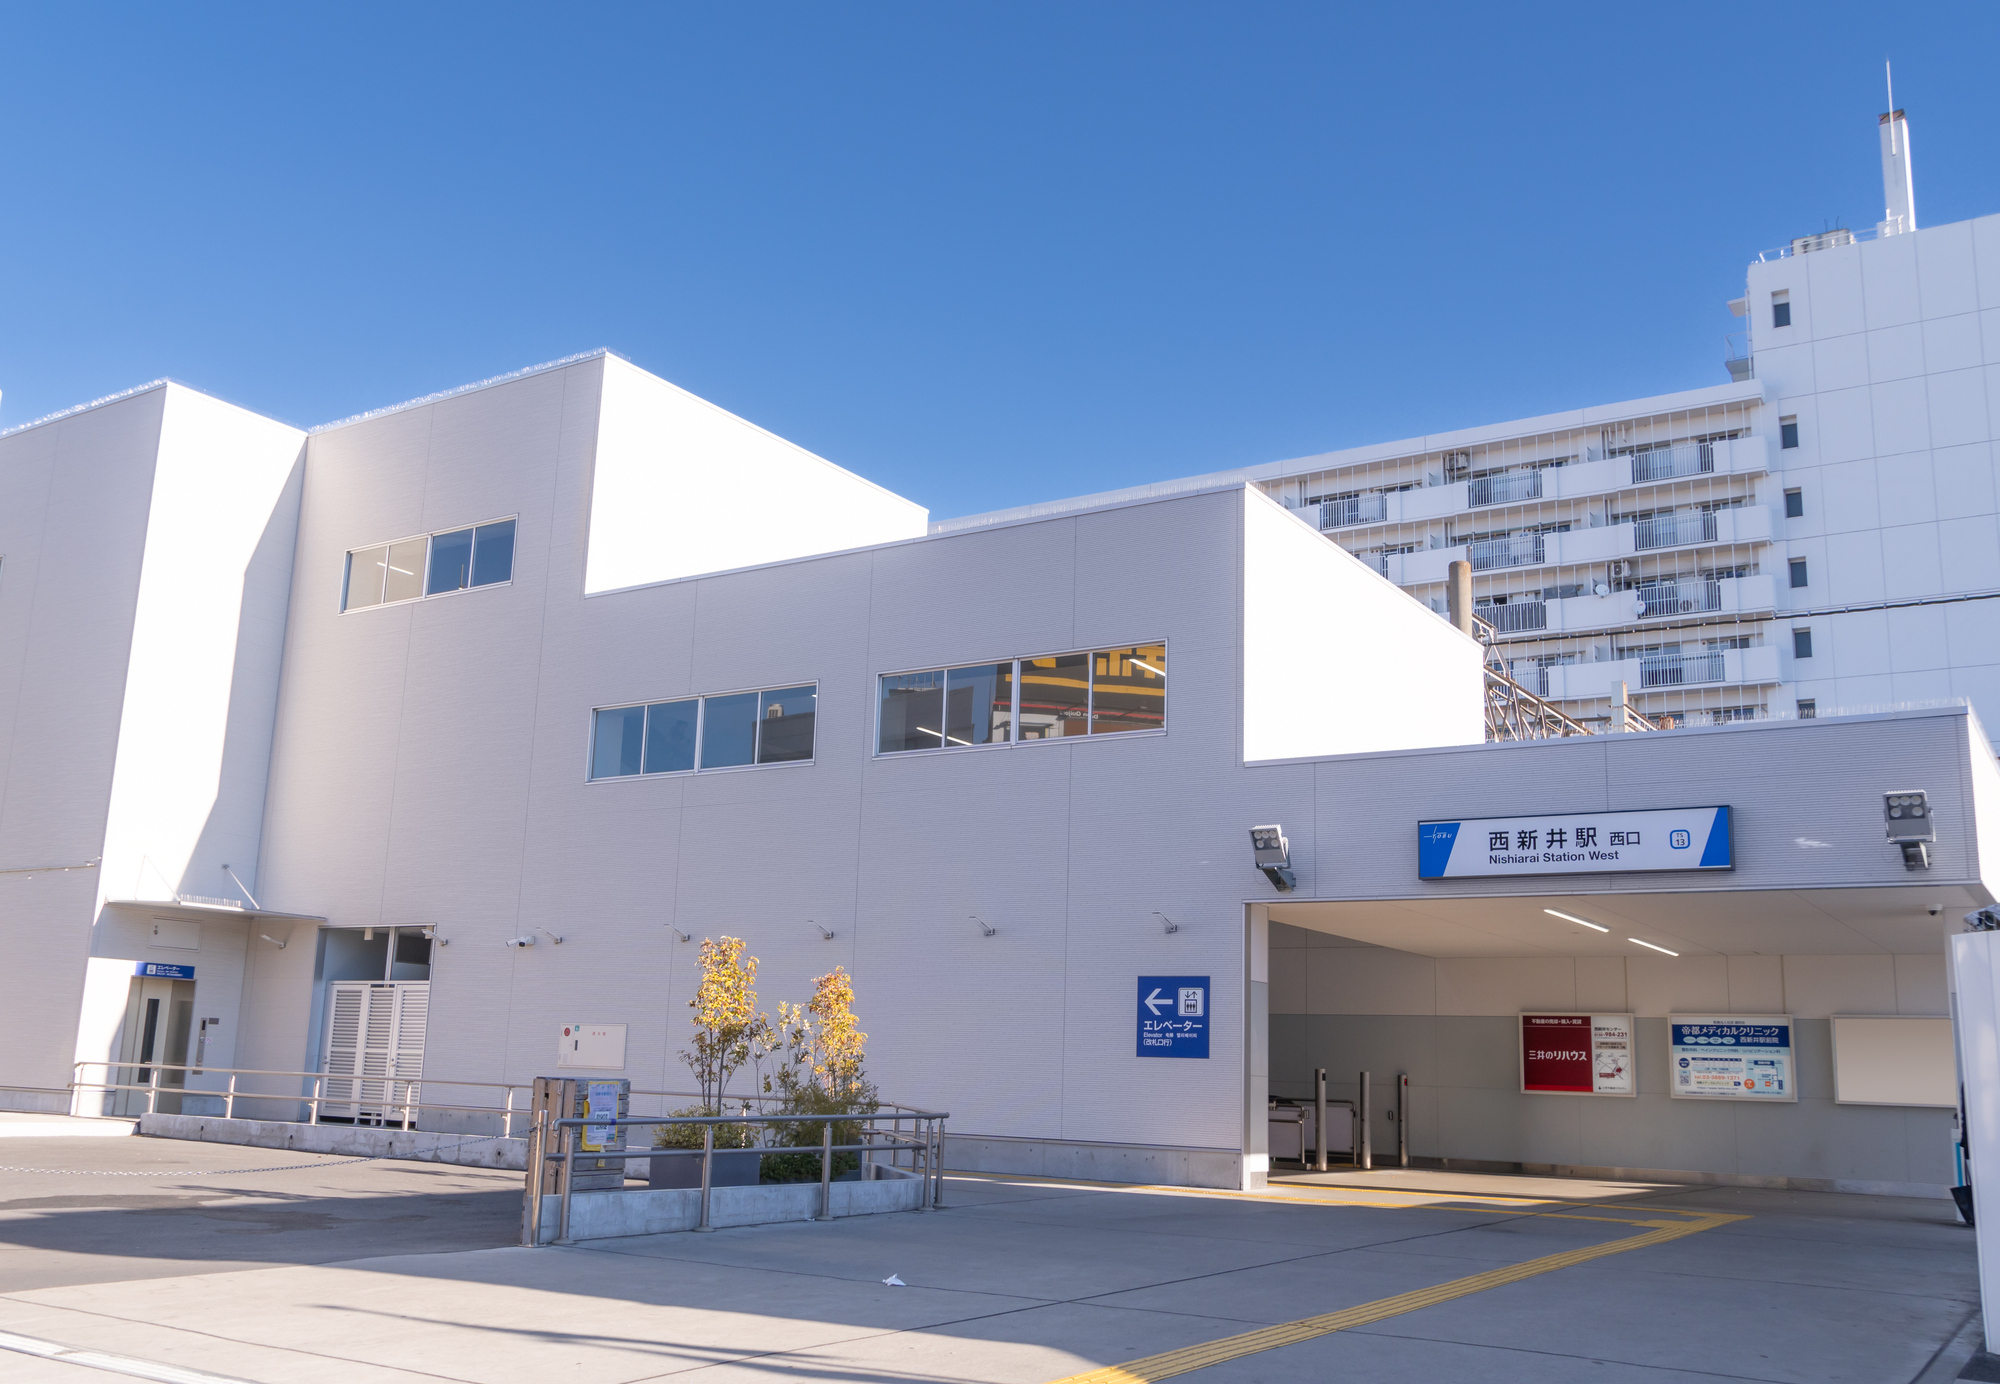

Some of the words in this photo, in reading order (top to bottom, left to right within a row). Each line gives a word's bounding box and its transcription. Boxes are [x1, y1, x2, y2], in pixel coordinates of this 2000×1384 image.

[1488, 827, 1598, 851] 西新井駅
[1609, 831, 1641, 846] 西口
[1675, 838, 1685, 846] 13
[1488, 852, 1540, 865] Nishiarai
[1543, 851, 1585, 863] Station
[1588, 850, 1619, 861] West
[1143, 1020, 1202, 1031] エレベーター
[1681, 1026, 1779, 1036] 帝都メディカルクリニック
[1528, 1050, 1587, 1061] 三井のリハウス
